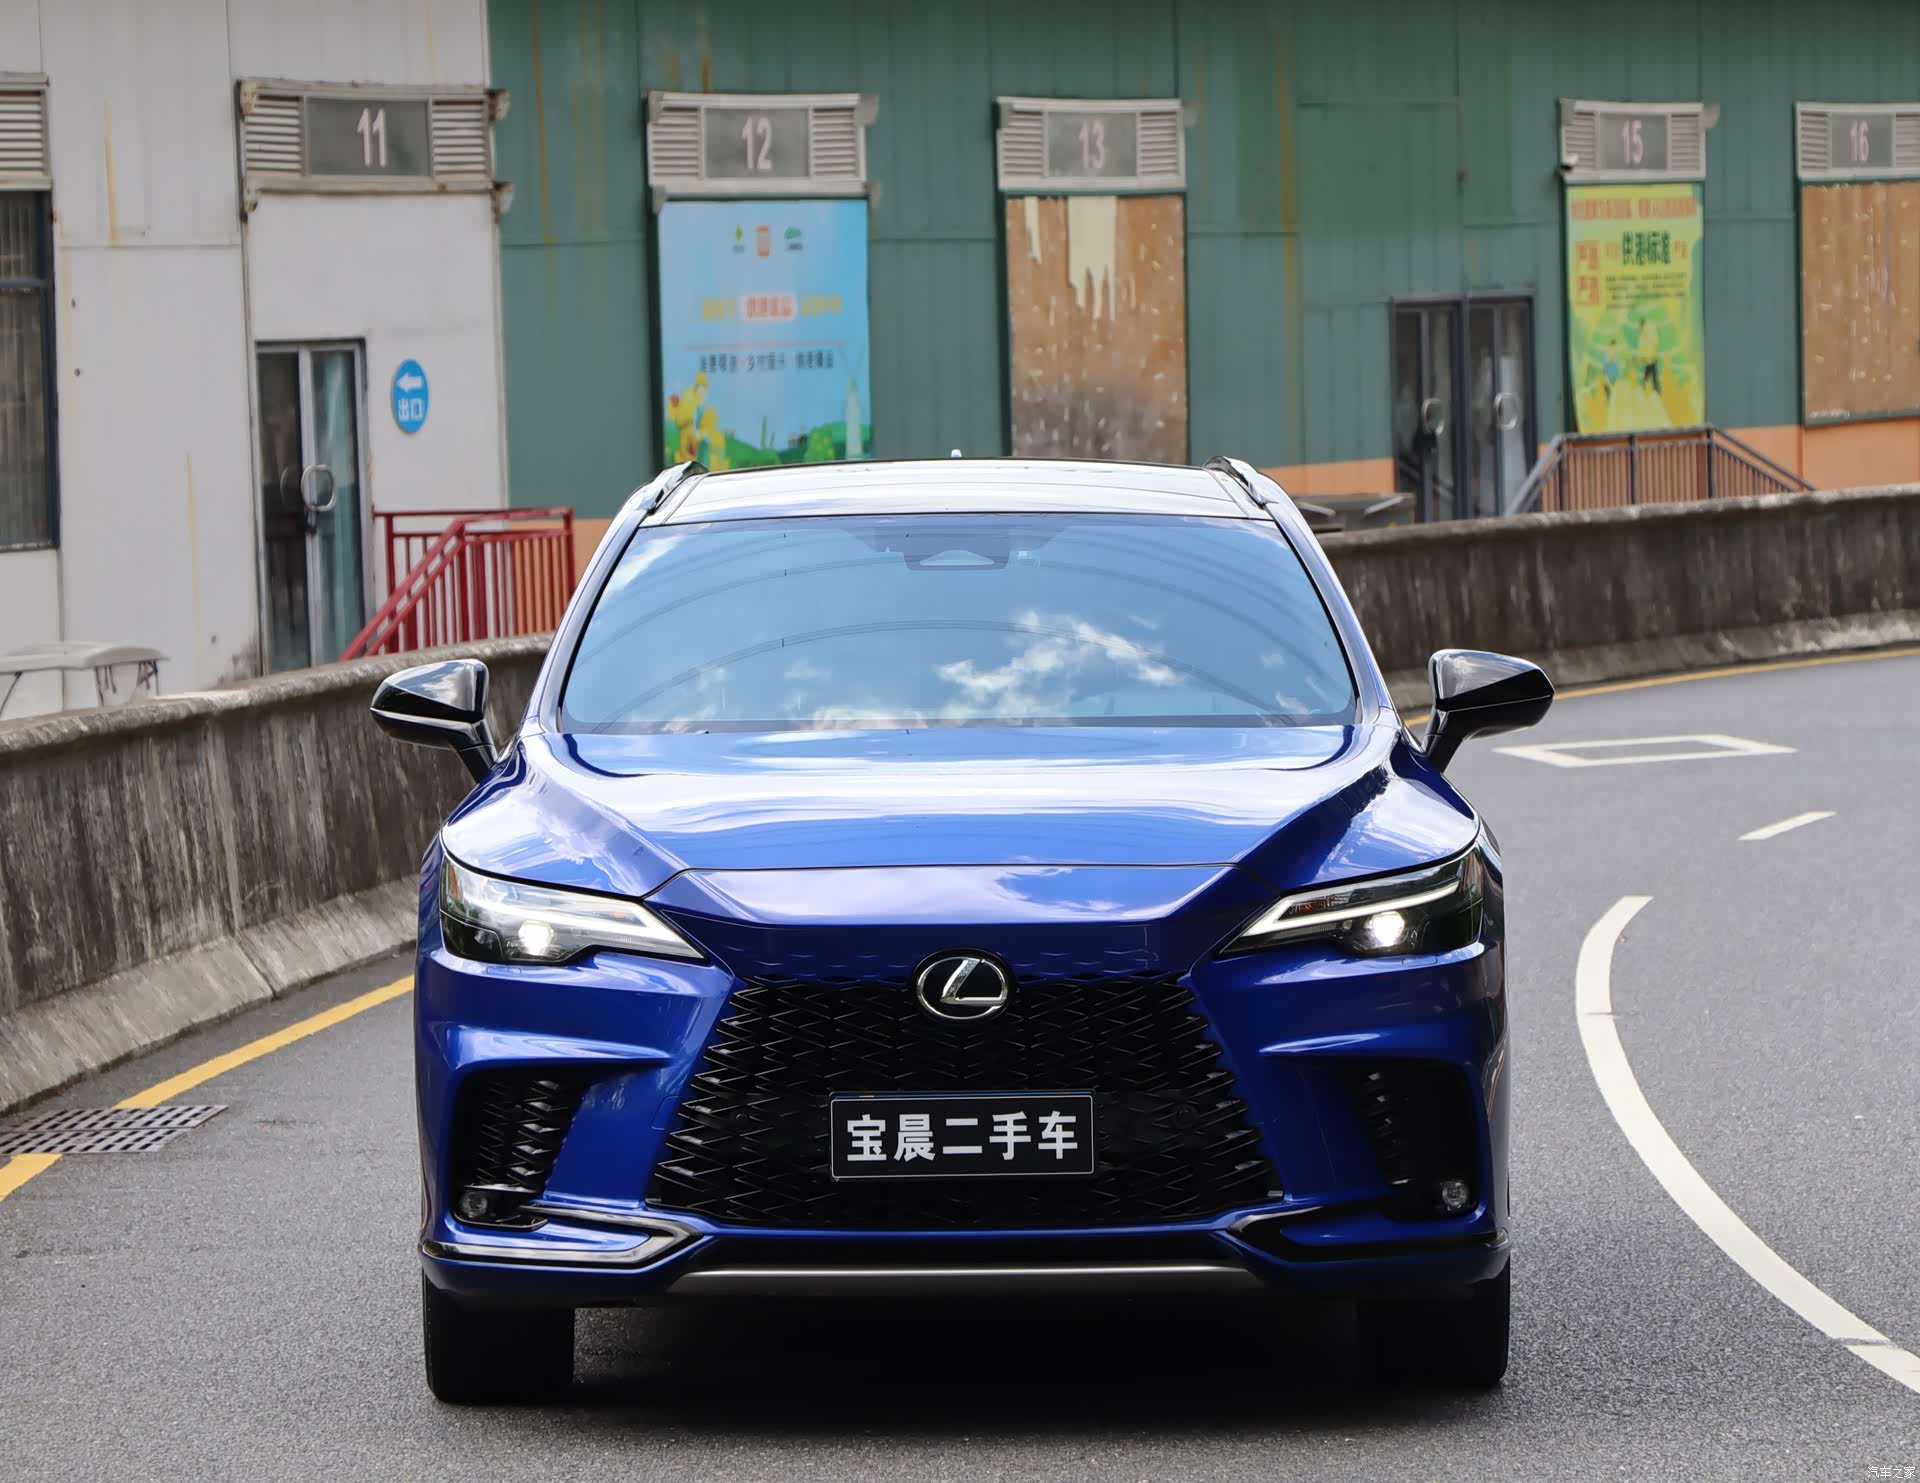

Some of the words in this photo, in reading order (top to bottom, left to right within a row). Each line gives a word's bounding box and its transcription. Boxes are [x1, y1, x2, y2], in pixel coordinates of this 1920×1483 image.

[357, 107, 387, 168] 11
[741, 116, 774, 171] 12
[1078, 118, 1105, 169] 13
[1622, 119, 1643, 164] 15
[1850, 120, 1869, 163] 16
[398, 398, 424, 421] 出口
[846, 1110, 1079, 1163] 宝晨二手车
